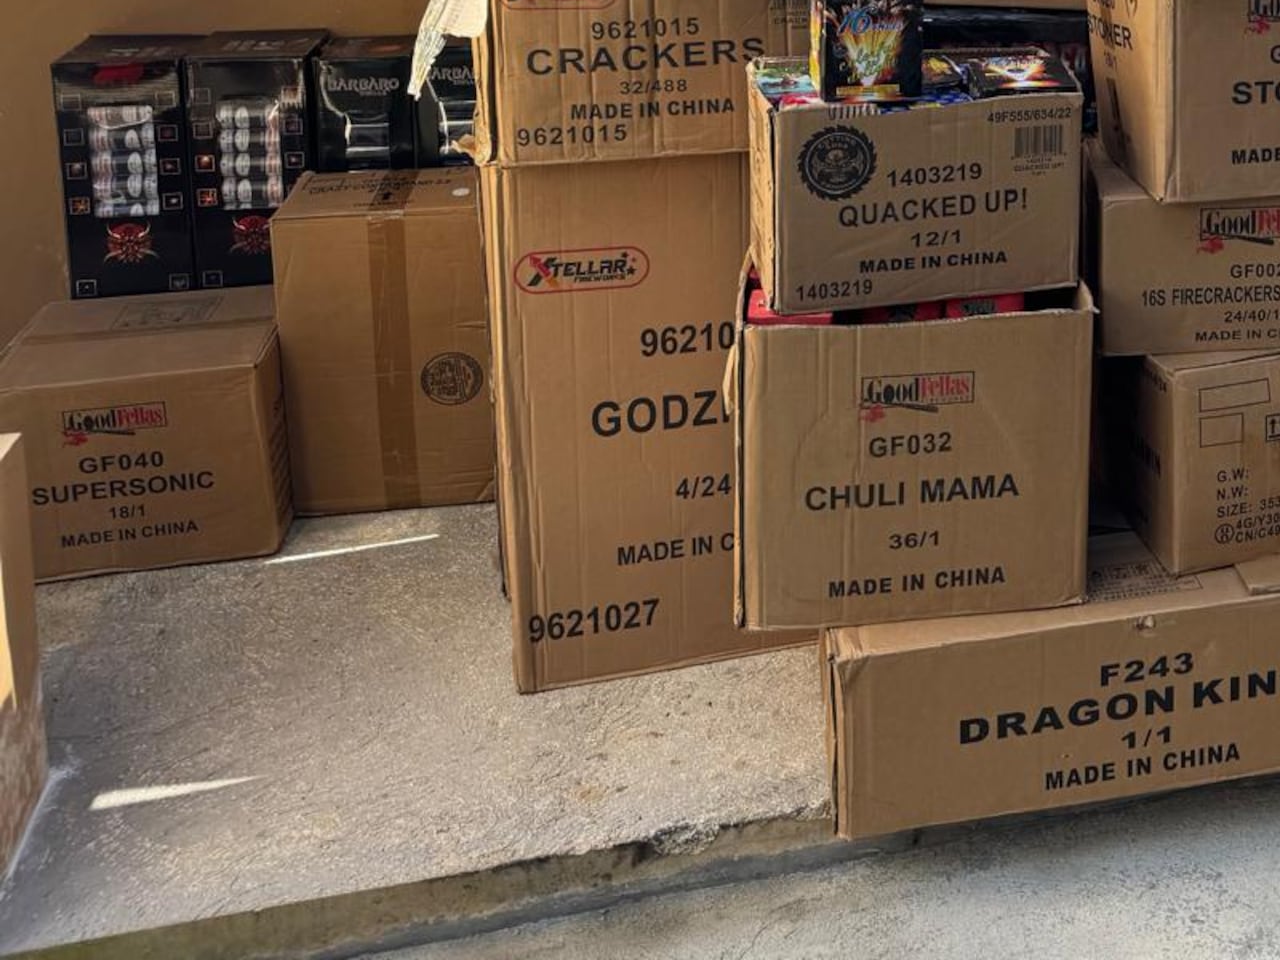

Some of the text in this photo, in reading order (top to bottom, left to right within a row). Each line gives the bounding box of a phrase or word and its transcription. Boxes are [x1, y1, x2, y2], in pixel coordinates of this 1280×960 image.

[592, 17, 700, 41] 9621015
[527, 38, 766, 76] CRACKERS
[620, 79, 688, 95] 32/488
[571, 98, 735, 121] MADE IN CHINA
[517, 124, 628, 147] 9621015
[887, 163, 982, 187] 1403219
[839, 188, 1028, 227] QUACKED UP!
[911, 230, 961, 248] 12/1
[860, 251, 1008, 273] MADE IN CHINA
[796, 280, 873, 302] 1403219
[1142, 290, 1166, 306] 16S
[1172, 285, 1280, 305] FIRECRACKERS
[640, 321, 734, 357] 96210
[1195, 330, 1241, 341] MADE
[1247, 330, 1261, 339] IN
[869, 432, 952, 458] GF032
[79, 451, 164, 474] GF040
[676, 474, 731, 500] 4/24
[1217, 469, 1249, 482] G.W:
[33, 472, 215, 505] SUPERSONIC
[805, 474, 1019, 512] CHULI MAMA
[1216, 487, 1249, 500] N.W:
[110, 505, 145, 520] 18/1
[1217, 503, 1252, 518] SIZE:
[61, 520, 198, 548] MADE IN CHINA
[889, 531, 939, 550] 36/1
[617, 536, 712, 566] MADE IN
[829, 567, 1005, 598] MADE IN CHINA
[530, 599, 659, 643] 9621027
[1101, 652, 1194, 687] F243
[959, 686, 1176, 745] DRAGON
[1121, 727, 1172, 750] 1/1
[1046, 743, 1240, 791] MADE IN CHINA
